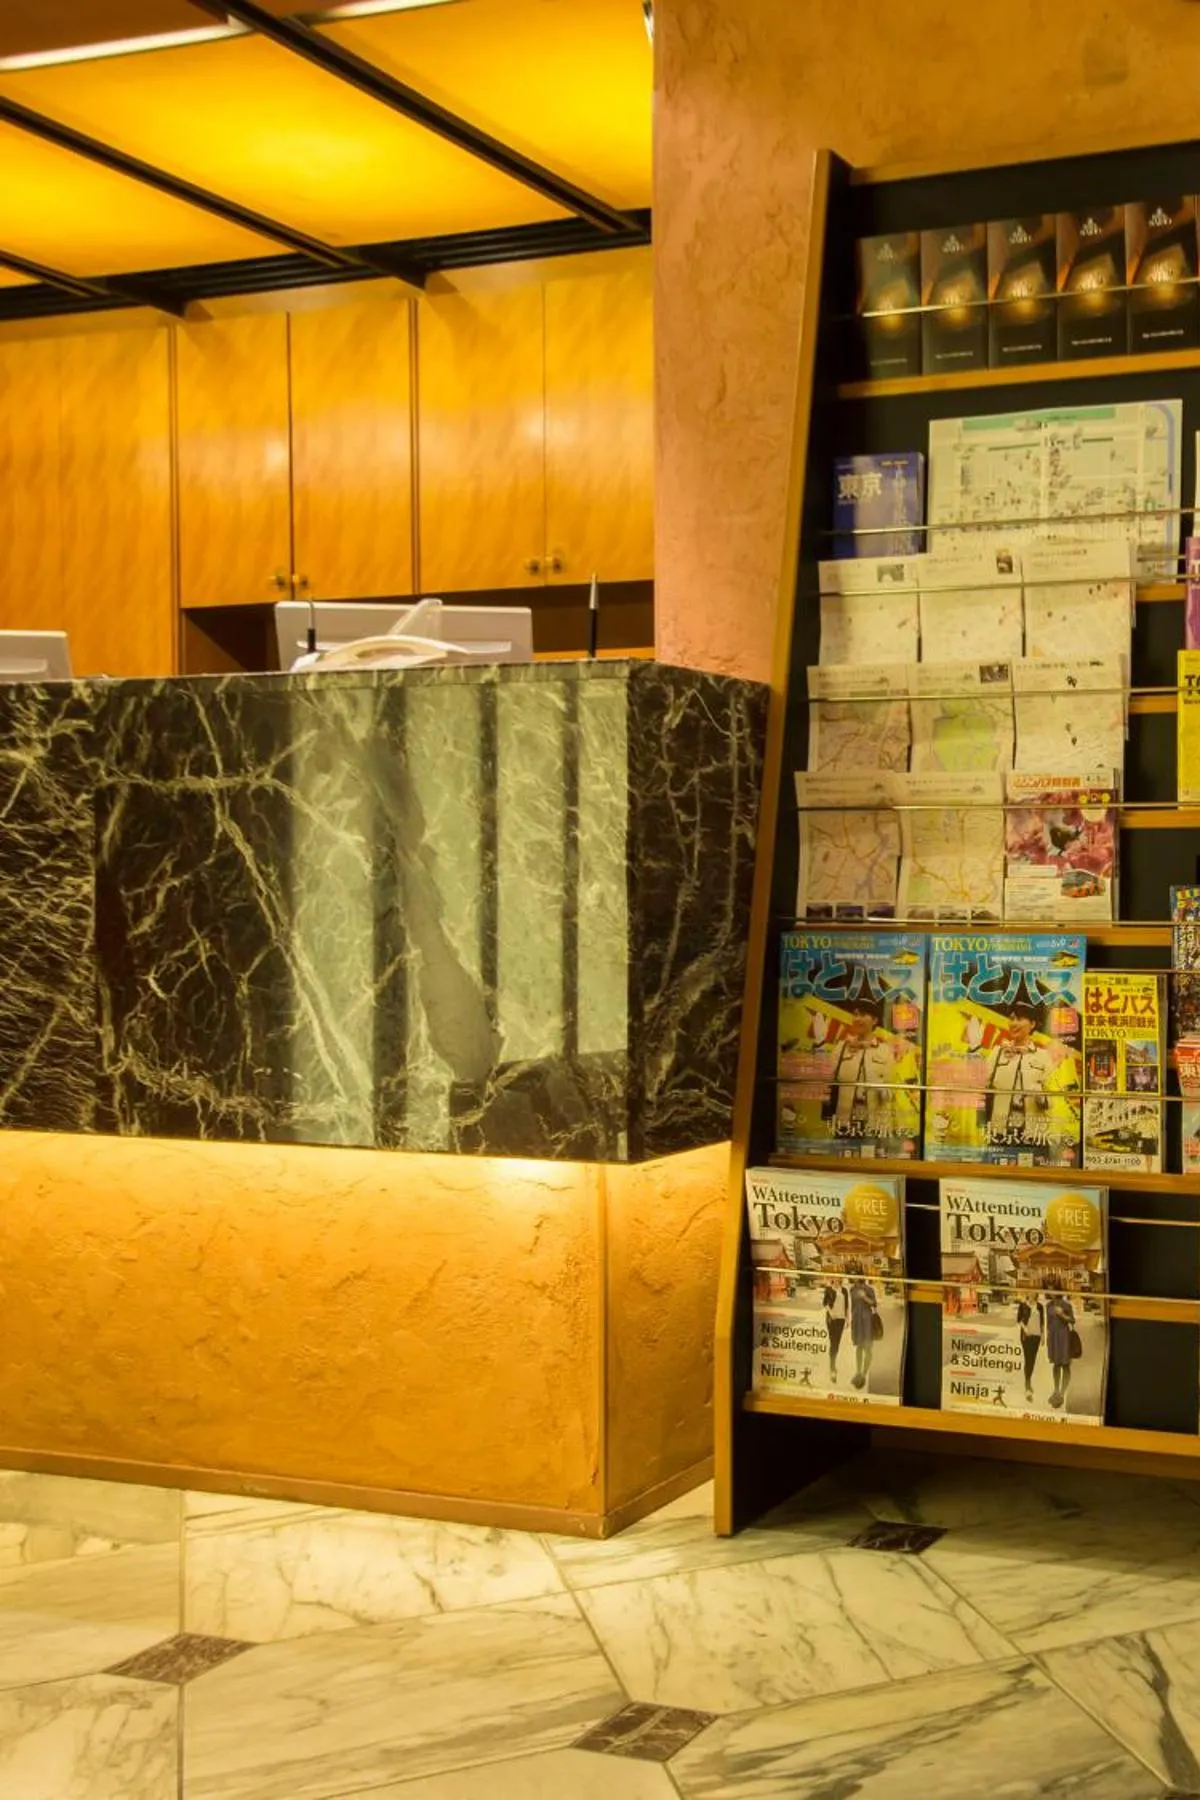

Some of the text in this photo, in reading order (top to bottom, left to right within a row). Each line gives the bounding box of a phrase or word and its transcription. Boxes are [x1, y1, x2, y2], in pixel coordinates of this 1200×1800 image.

[838, 472, 882, 500] 東京
[782, 935, 832, 949] TOKYO
[932, 937, 988, 952] TOKYO
[782, 950, 918, 1002] はとバス
[932, 952, 1077, 1006] はとバス
[1085, 986, 1156, 1015] はとバス
[1085, 1028, 1128, 1038] TOKYO
[752, 1185, 841, 1207] WAttention
[855, 1199, 889, 1216] FREE
[947, 1195, 1042, 1218] WAttention
[753, 1202, 844, 1238] Tokyo
[1056, 1206, 1091, 1228] FREE
[947, 1212, 1044, 1249] Tokyo
[761, 1322, 828, 1338] Ningyocho
[761, 1336, 827, 1354] & Suitengu
[951, 1339, 1022, 1356] Ningyocho
[761, 1364, 797, 1380] Ninja
[951, 1354, 1022, 1373] & Suitengu
[951, 1381, 990, 1400] Ninja
